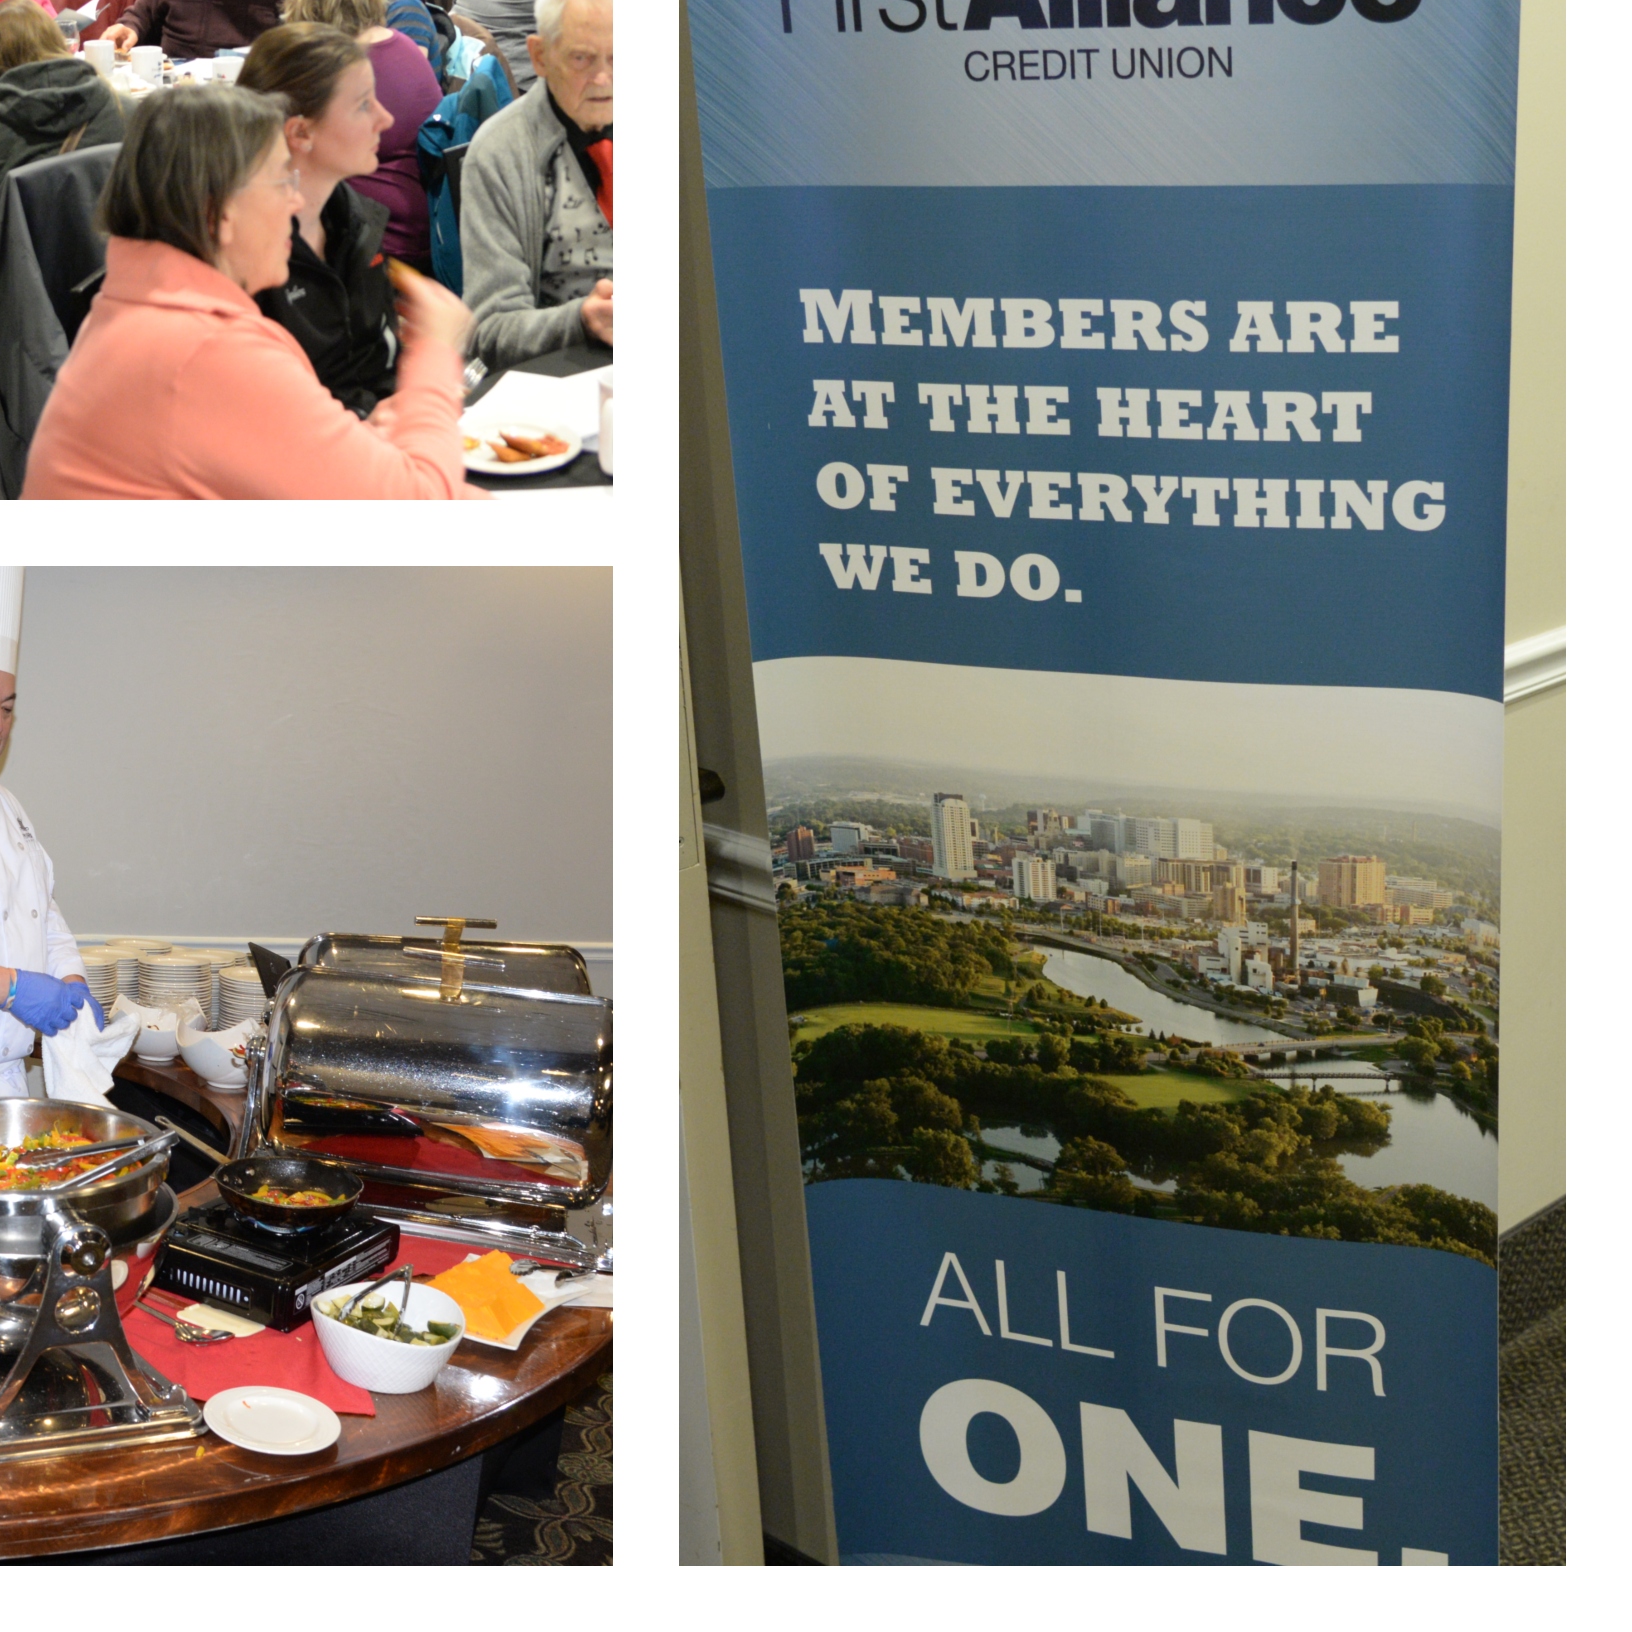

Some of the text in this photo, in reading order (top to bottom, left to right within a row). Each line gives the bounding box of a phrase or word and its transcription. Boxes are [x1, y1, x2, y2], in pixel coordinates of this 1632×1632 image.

[964, 46, 1234, 82] CREDIT UNION
[799, 288, 1400, 354] MEMBERS ARE
[807, 379, 1373, 443] AT THE HEART
[815, 461, 1447, 532] OF EVERYTHING
[818, 542, 1083, 603] WE DO.
[919, 1251, 1387, 1397] ALL FOR
